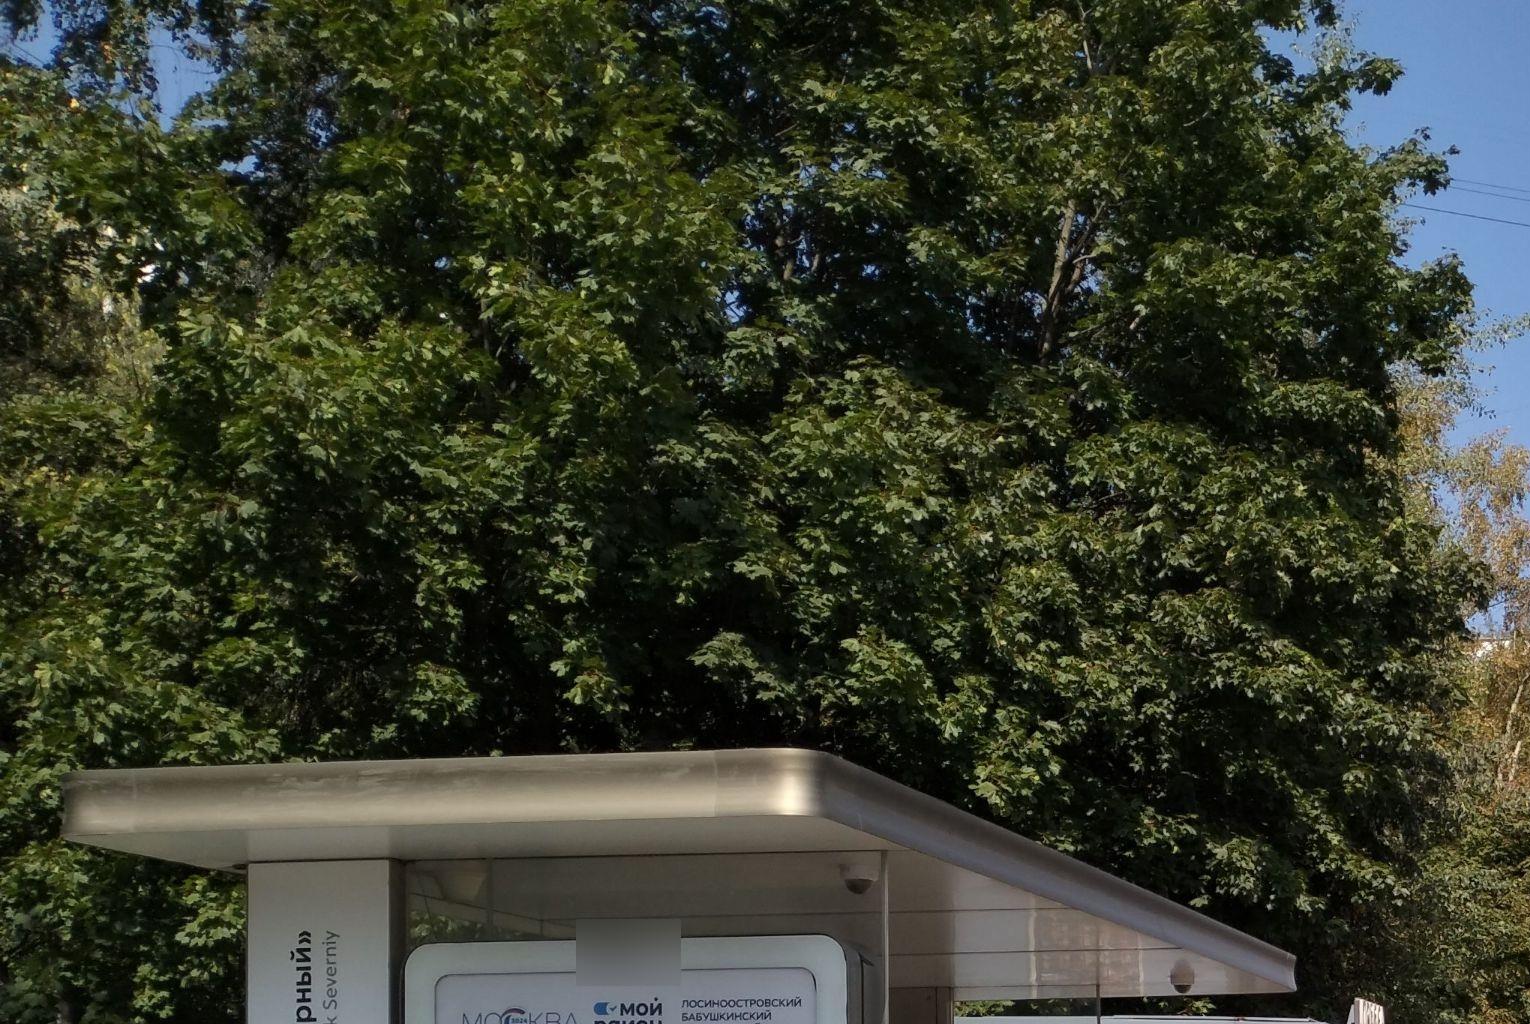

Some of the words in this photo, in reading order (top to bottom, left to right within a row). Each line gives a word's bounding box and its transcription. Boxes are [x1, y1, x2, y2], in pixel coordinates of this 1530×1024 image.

[322, 930, 340, 1010] Severniy
[681, 997, 801, 1008] ЛОСИНООСТРОВСКИЙ
[681, 1010, 772, 1022] БАБУШКИНСКИЙ
